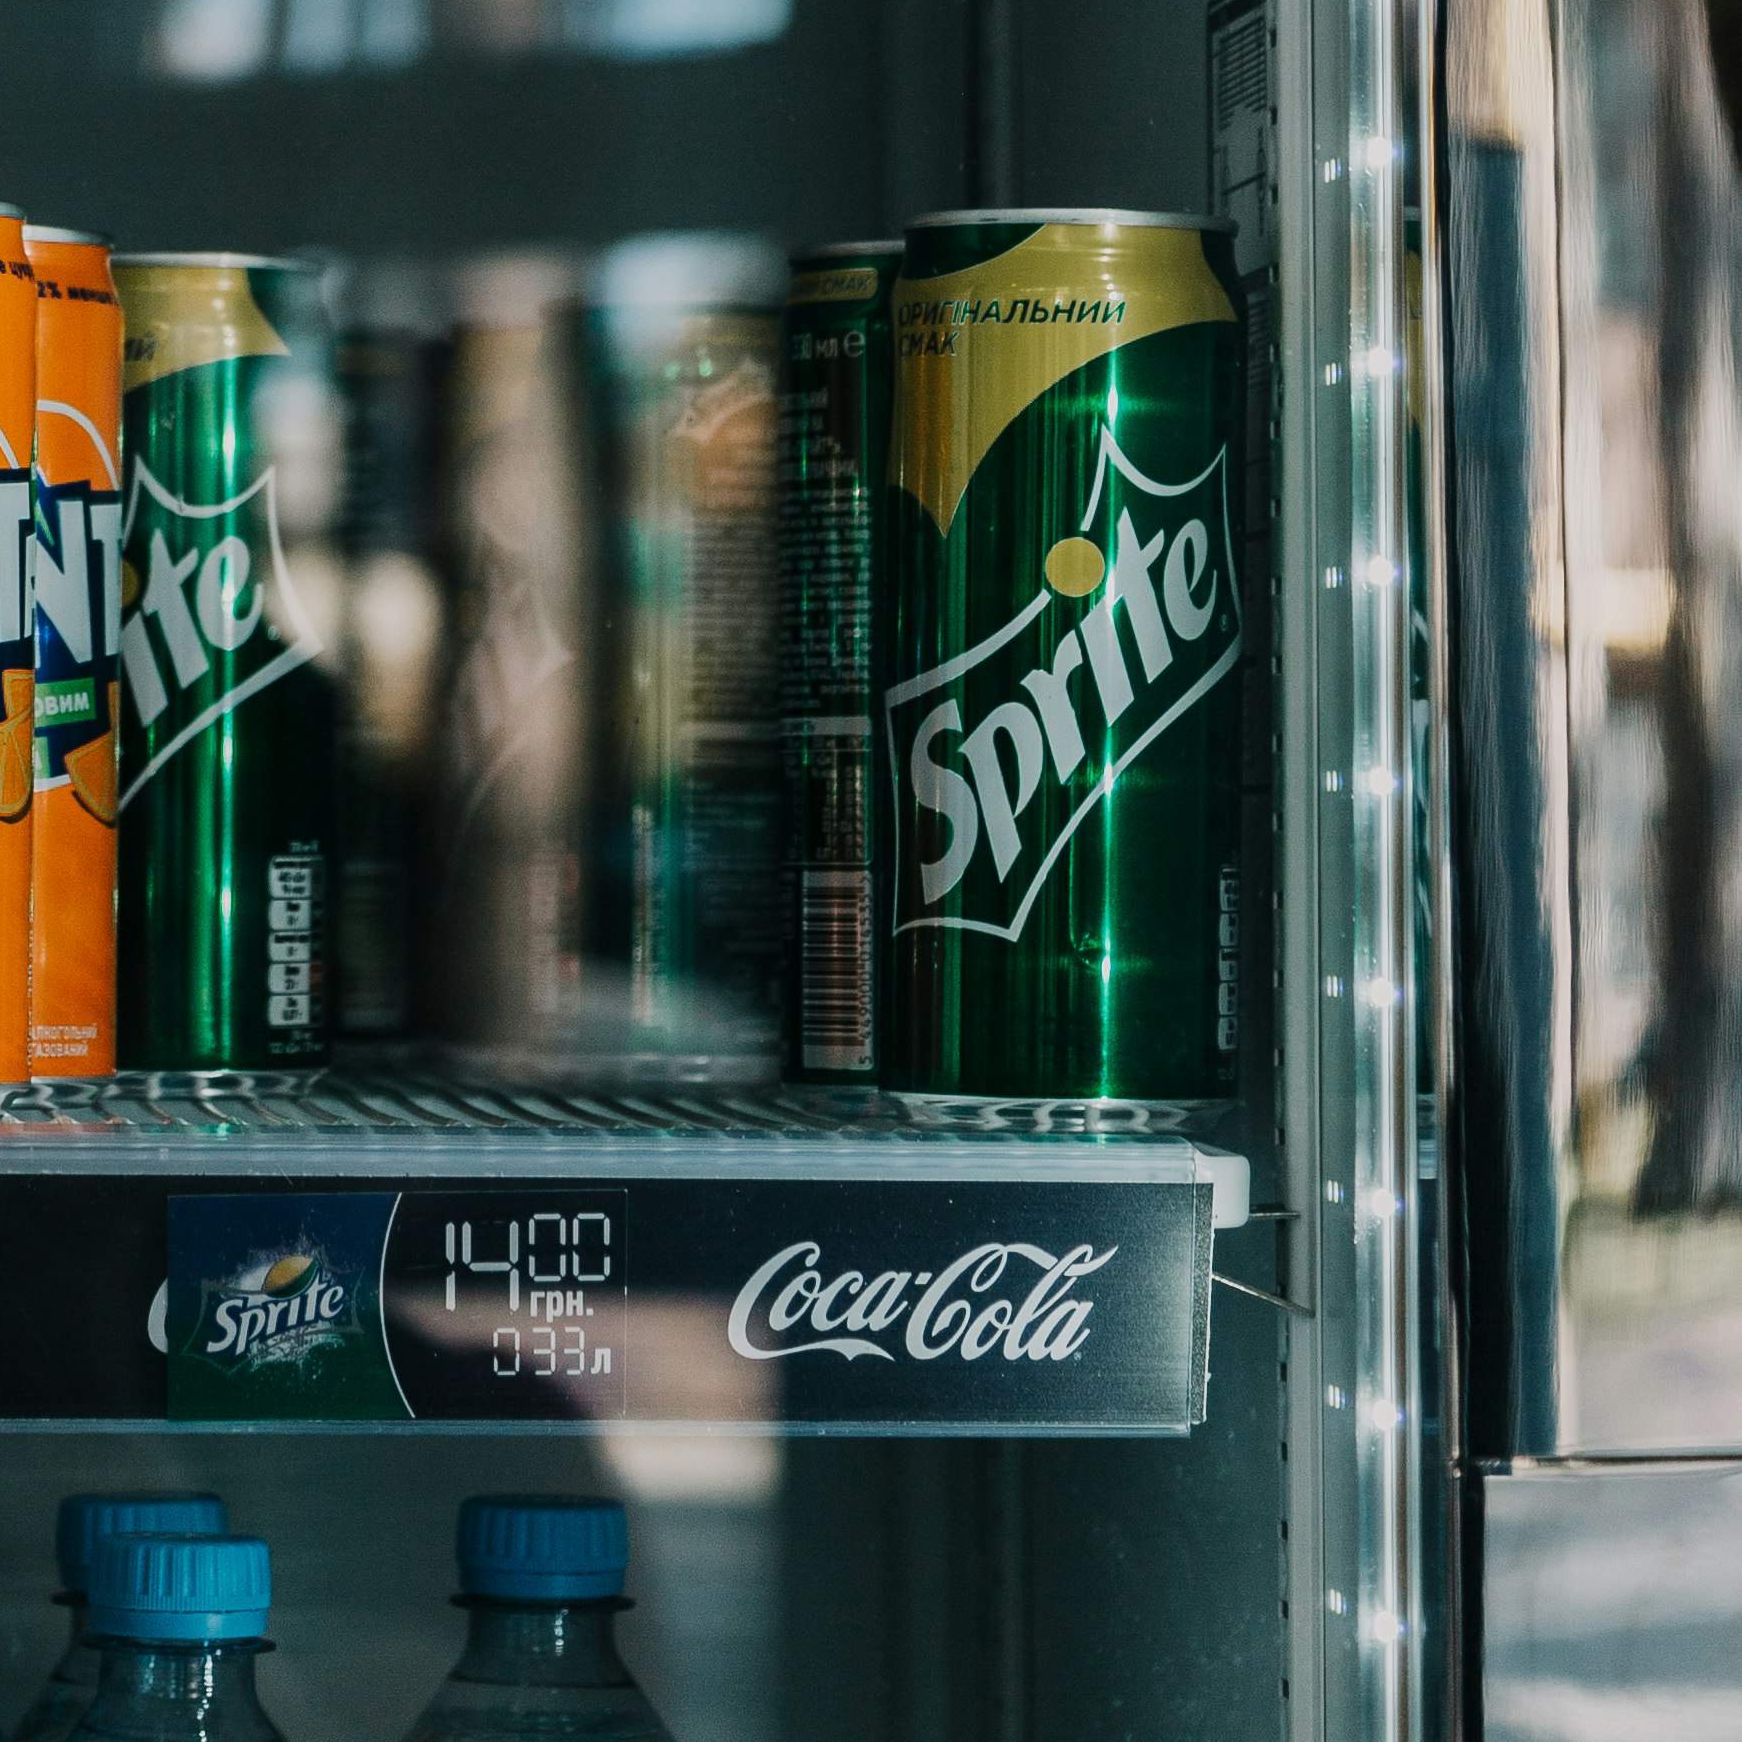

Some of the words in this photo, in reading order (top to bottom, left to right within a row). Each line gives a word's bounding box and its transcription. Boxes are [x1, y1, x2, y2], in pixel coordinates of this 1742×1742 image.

[899, 329, 959, 357] СМАК
[911, 505, 1219, 906] Sprite
[206, 1279, 345, 1356] Sprite
[529, 1290, 595, 1323] грн.
[727, 1241, 1119, 1362] Coca-Cola
